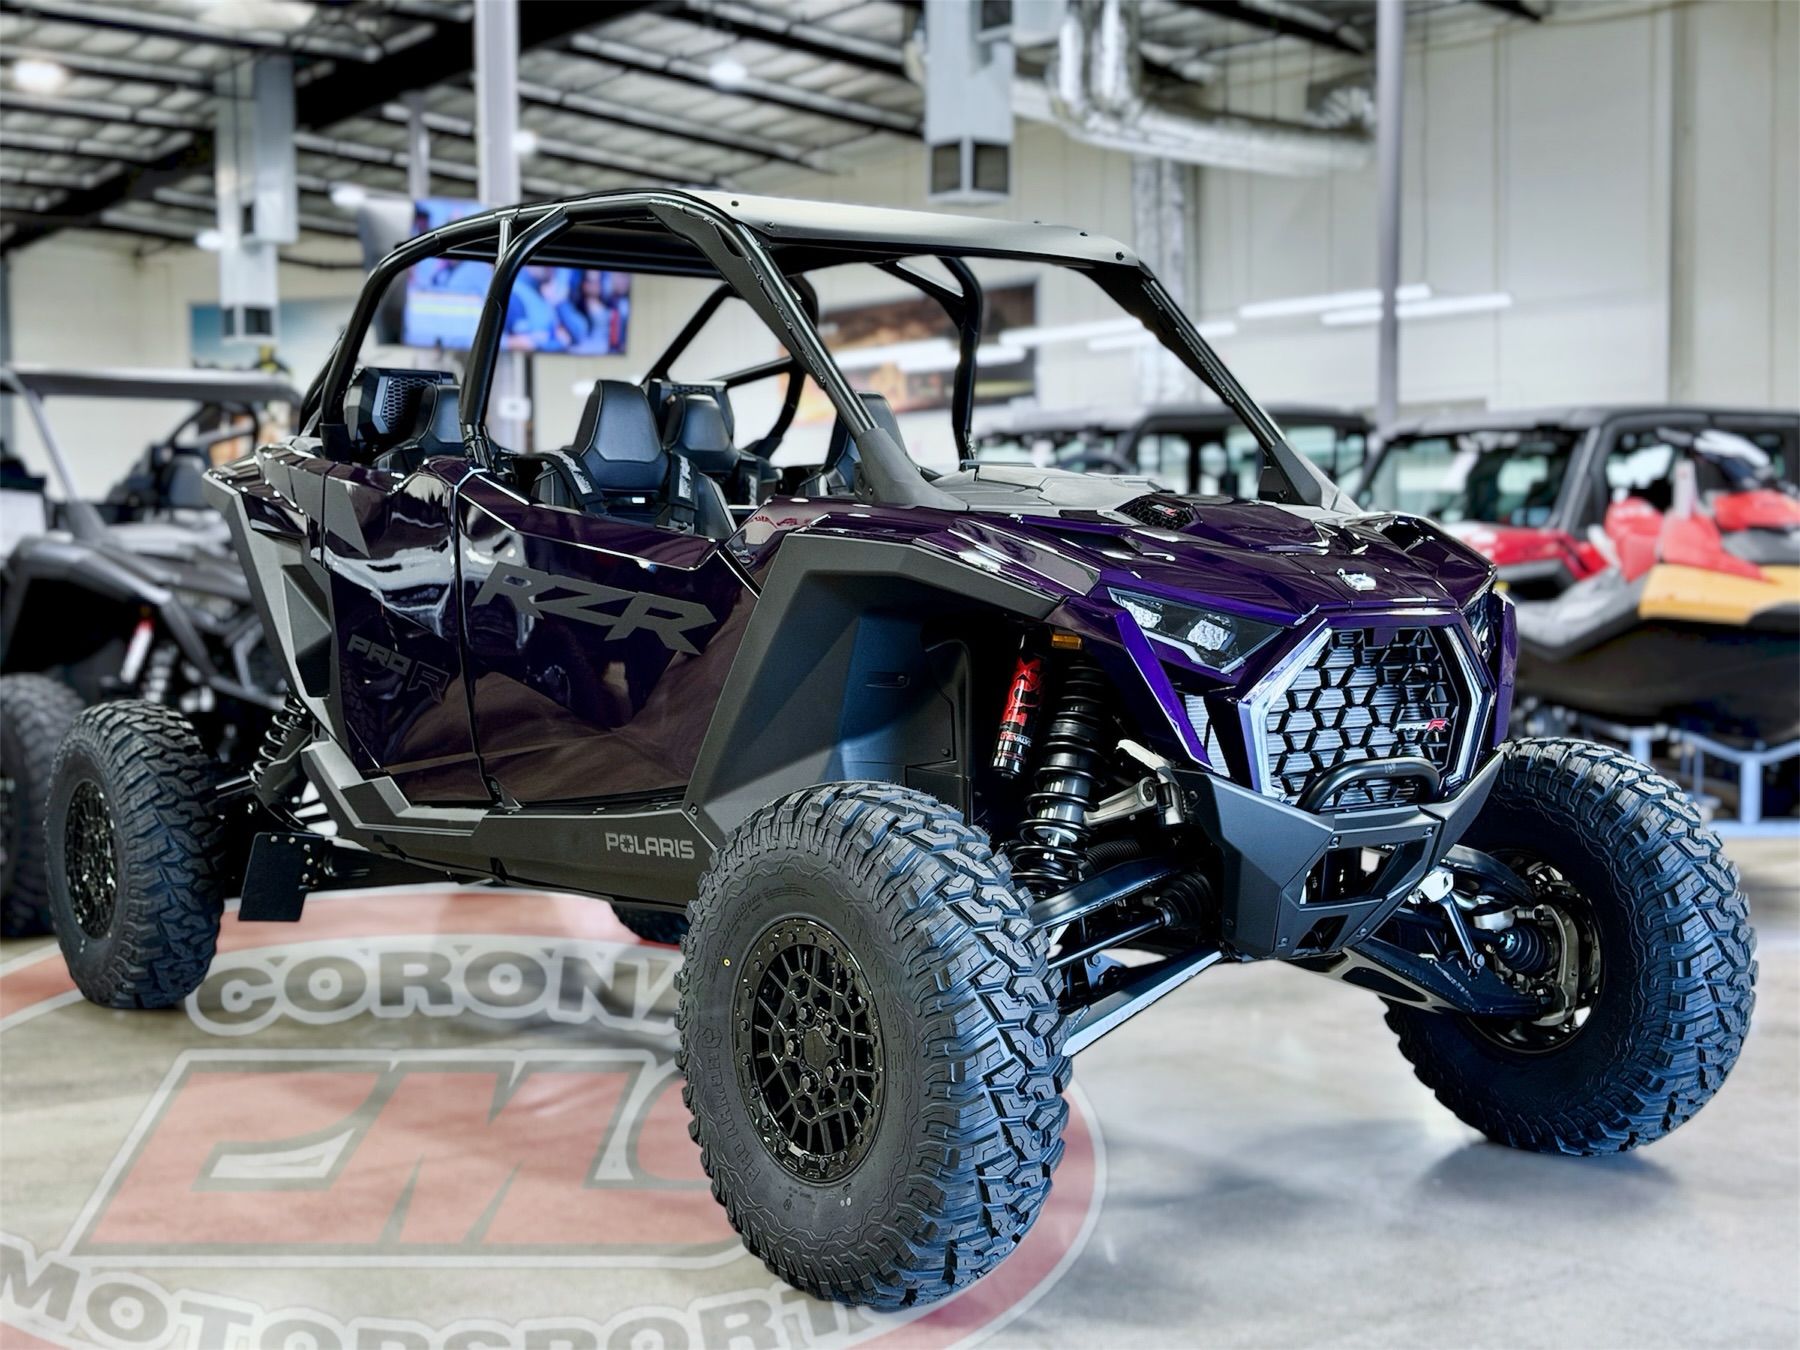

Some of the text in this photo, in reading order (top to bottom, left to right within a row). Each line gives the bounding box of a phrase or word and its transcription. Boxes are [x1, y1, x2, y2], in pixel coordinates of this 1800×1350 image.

[471, 561, 717, 656] RZR
[347, 633, 412, 676] PRO
[605, 832, 695, 859] POLARIS
